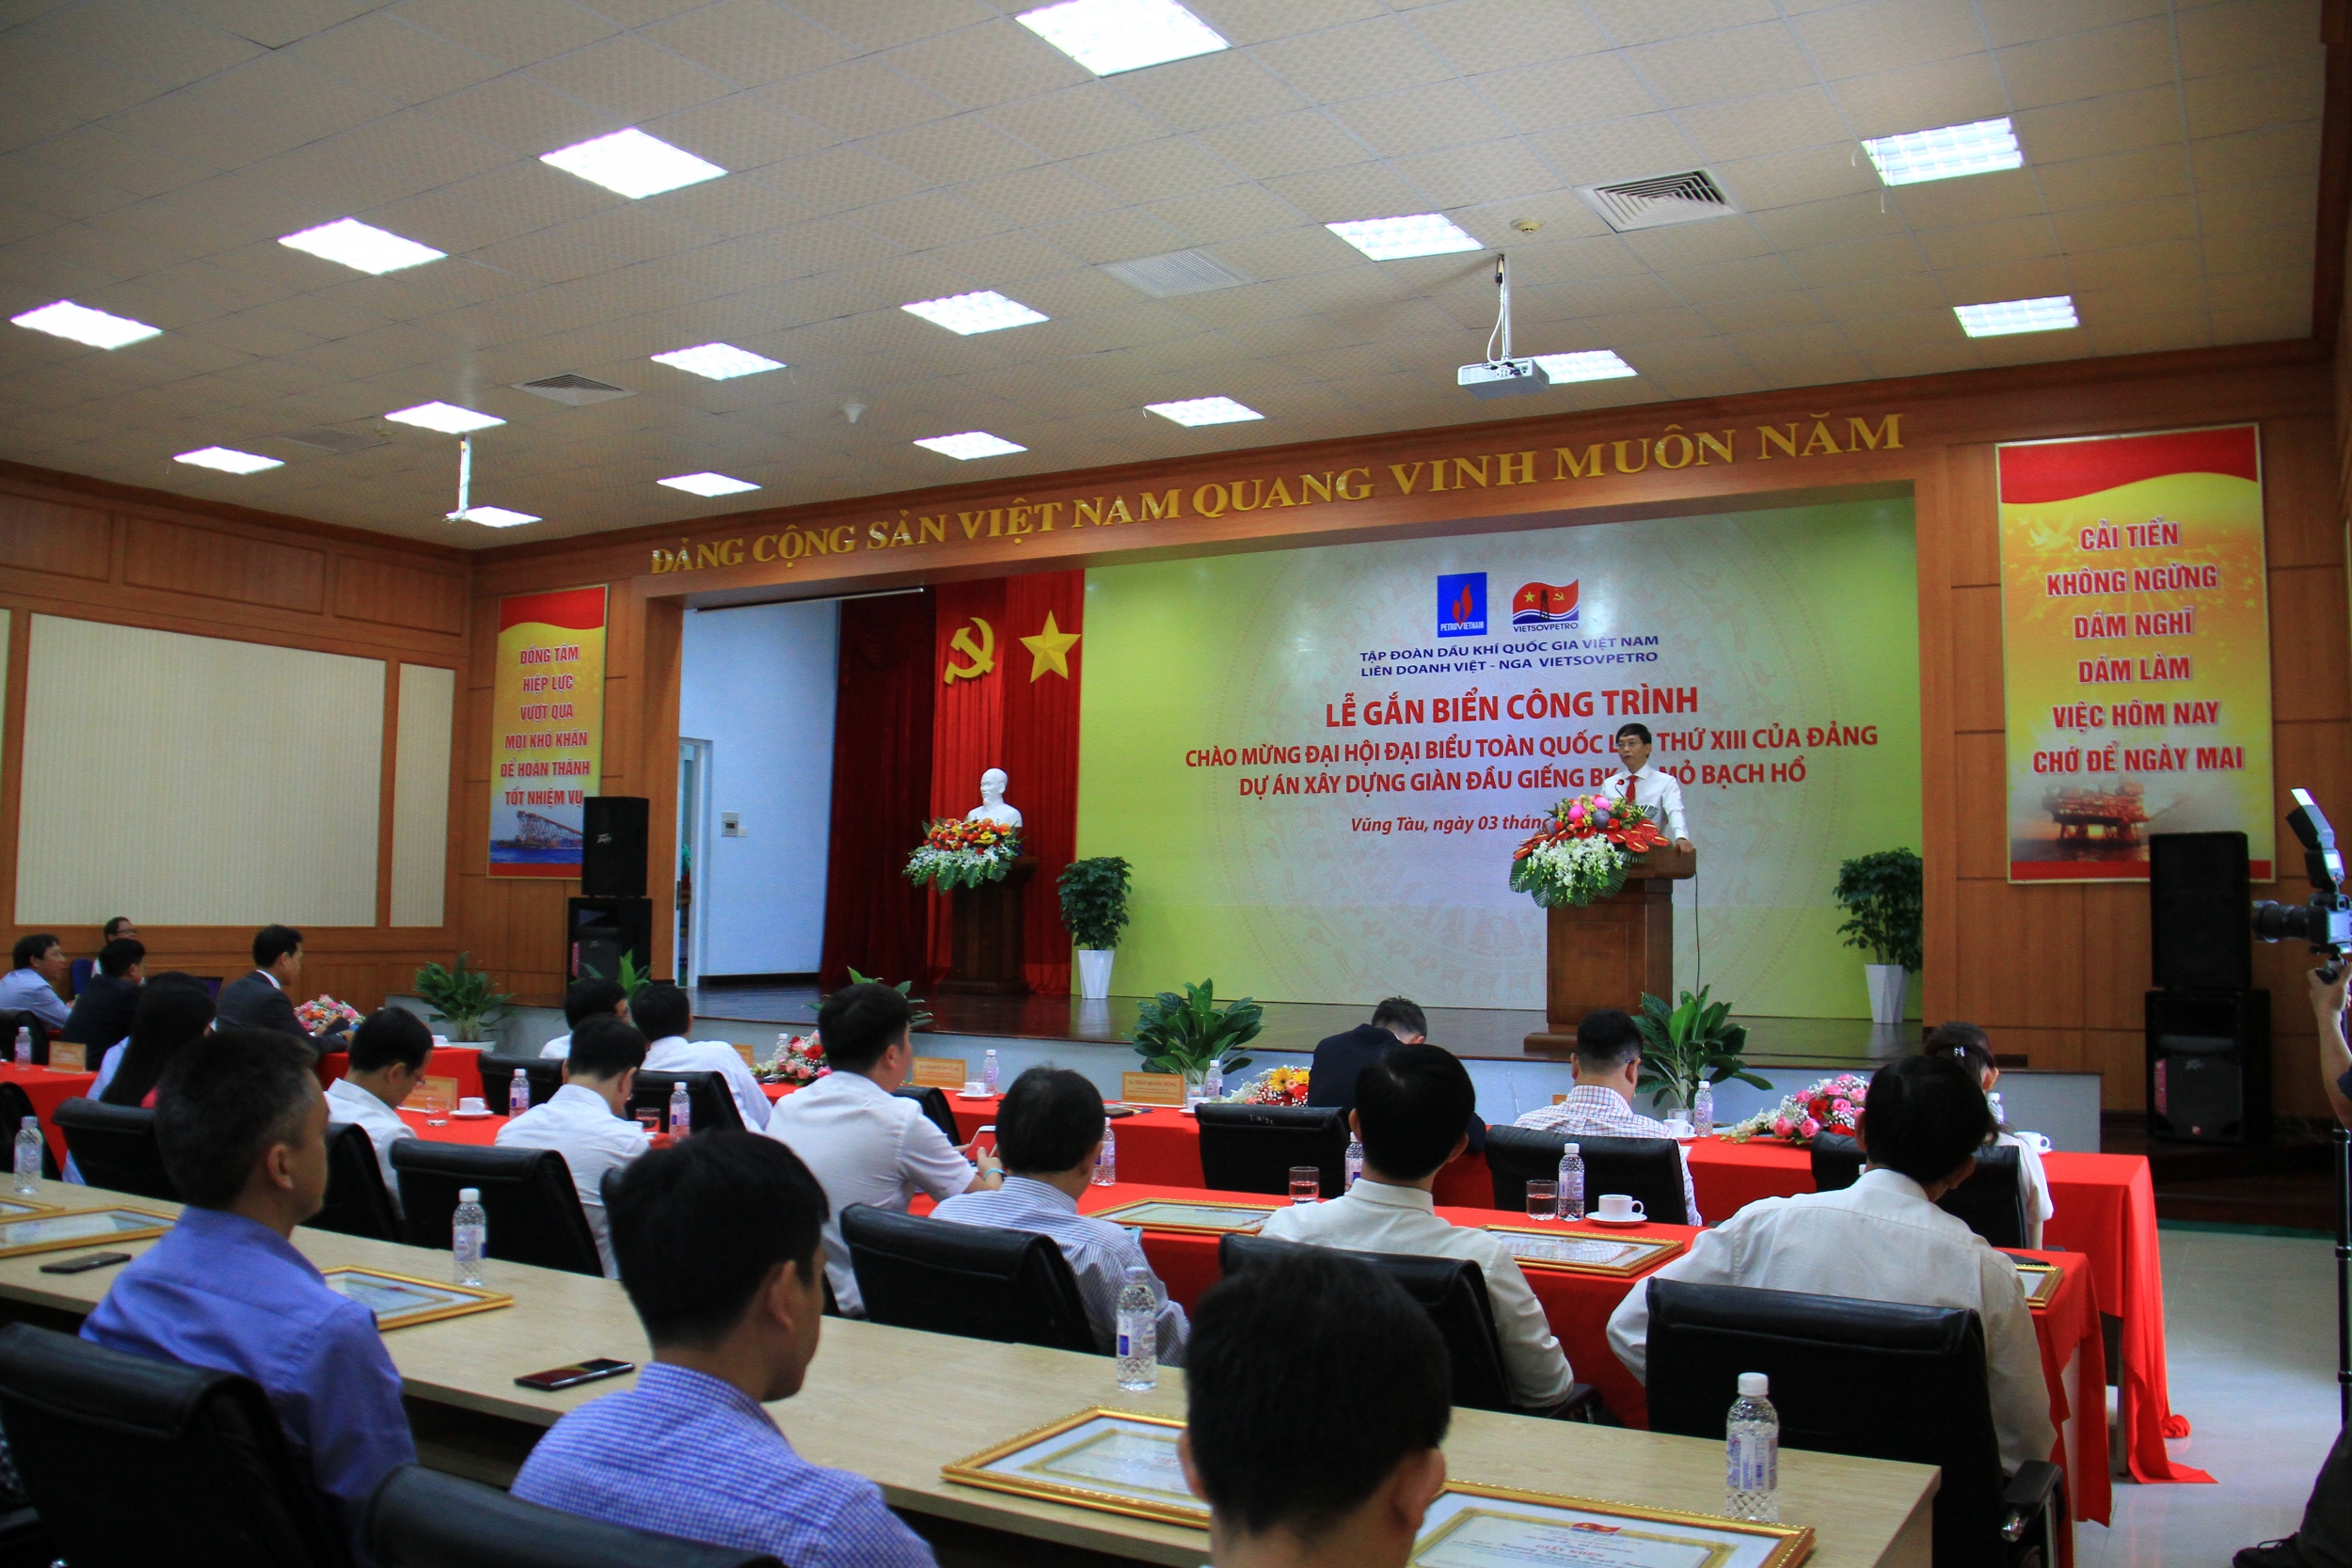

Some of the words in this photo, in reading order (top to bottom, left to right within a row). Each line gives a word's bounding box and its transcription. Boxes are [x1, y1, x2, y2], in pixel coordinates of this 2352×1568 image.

[650, 535, 744, 575] ĐẢNG
[754, 524, 856, 568] CỘNG
[866, 514, 947, 551] SẢN
[956, 497, 1062, 546] VIỆT
[1072, 487, 1182, 528] NAM
[1192, 468, 1375, 517] QUANG
[1389, 450, 1540, 495] VINH
[1553, 423, 1737, 481] MUÔN
[1756, 412, 1903, 460] NĂM
[2080, 519, 2119, 550] CẢI
[2126, 515, 2179, 546] TIẾN
[2047, 567, 2126, 596] KHÔNG
[2135, 562, 2218, 592] NGỪNG
[1440, 622, 1484, 631] PETROVIETNAM
[1514, 623, 1578, 632] VIETSOVPETRO
[2074, 610, 2126, 639] DÁM
[2136, 607, 2193, 636] NGHĨ
[554, 643, 579, 661] TÂM
[1360, 651, 1386, 663] TẬP
[1391, 647, 1433, 659] ĐOÀN
[1438, 645, 1469, 657] DẦU
[1473, 643, 1499, 655] KHÍ
[1502, 641, 1547, 654] QUỐC
[1552, 641, 1578, 650] GIA
[1582, 637, 1616, 650] VIỆT
[1621, 636, 1659, 646] NAM
[1361, 667, 1391, 676] LIÊN
[1397, 663, 1450, 674] DOANH
[1454, 660, 1486, 673] VIỆT
[1499, 659, 1532, 669] NGA
[1539, 652, 1658, 667] VIETSOVPETRO
[2079, 655, 2132, 683] DÁM
[2139, 652, 2190, 680] LÀM
[523, 674, 548, 695] HIỆP
[552, 674, 573, 694] LỰC
[520, 705, 548, 722] VƯỢT
[551, 704, 573, 720] QUA
[1327, 693, 1356, 727] LỄ
[1364, 692, 1422, 725] GẮN
[1433, 688, 1499, 722] BIỂN
[1507, 688, 1594, 720] CÔNG
[1602, 683, 1697, 716] TRÌNH
[2053, 702, 2104, 733] VIỆC
[2113, 699, 2165, 726] HÔM
[2174, 702, 2219, 724] NAY
[505, 734, 527, 752] MỌI
[530, 729, 552, 748] KHÓ
[556, 729, 587, 747] KHĂN
[1185, 749, 1237, 767] CHÀO
[1242, 744, 1300, 765] MỪNG
[1306, 745, 1339, 768] ĐẠI
[1345, 740, 1379, 766] HỘI
[1385, 742, 1420, 765] ĐẠI
[1426, 734, 1470, 759] BIỂU
[1476, 736, 1534, 756] TOÀN
[1540, 730, 1603, 757] QUỐC
[1658, 728, 1707, 752] THỨ
[1711, 731, 1746, 750] XIII
[1753, 723, 1801, 749] CỦA
[1806, 721, 1878, 747] ĐẢNG
[501, 758, 516, 777] ĐỂ
[518, 760, 548, 776] HOÀN
[552, 759, 590, 776] THÀNH
[2033, 747, 2080, 773] CHỚ
[2087, 741, 2118, 771] ĐỂ
[2124, 744, 2187, 771] NGÀY
[2196, 747, 2244, 769] MAI
[1240, 776, 1268, 800] DỰ
[1273, 774, 1299, 795] ÁN
[1305, 773, 1341, 794] XÂY
[1346, 772, 1405, 797] DỰNG
[1411, 769, 1460, 791] GIÀN
[1467, 766, 1512, 789] ĐẦU
[1518, 764, 1584, 788] GIẾNG
[1702, 764, 1763, 789] BẠCH
[1772, 755, 1805, 783] HỔ
[505, 786, 524, 805] TỐT
[528, 788, 564, 808] NHIỆM
[568, 790, 583, 808] VỤ
[1351, 817, 1391, 833] Vũng
[1396, 816, 1428, 832] Tàu,
[1433, 817, 1473, 833] ngày
[1478, 817, 1498, 829] 03
